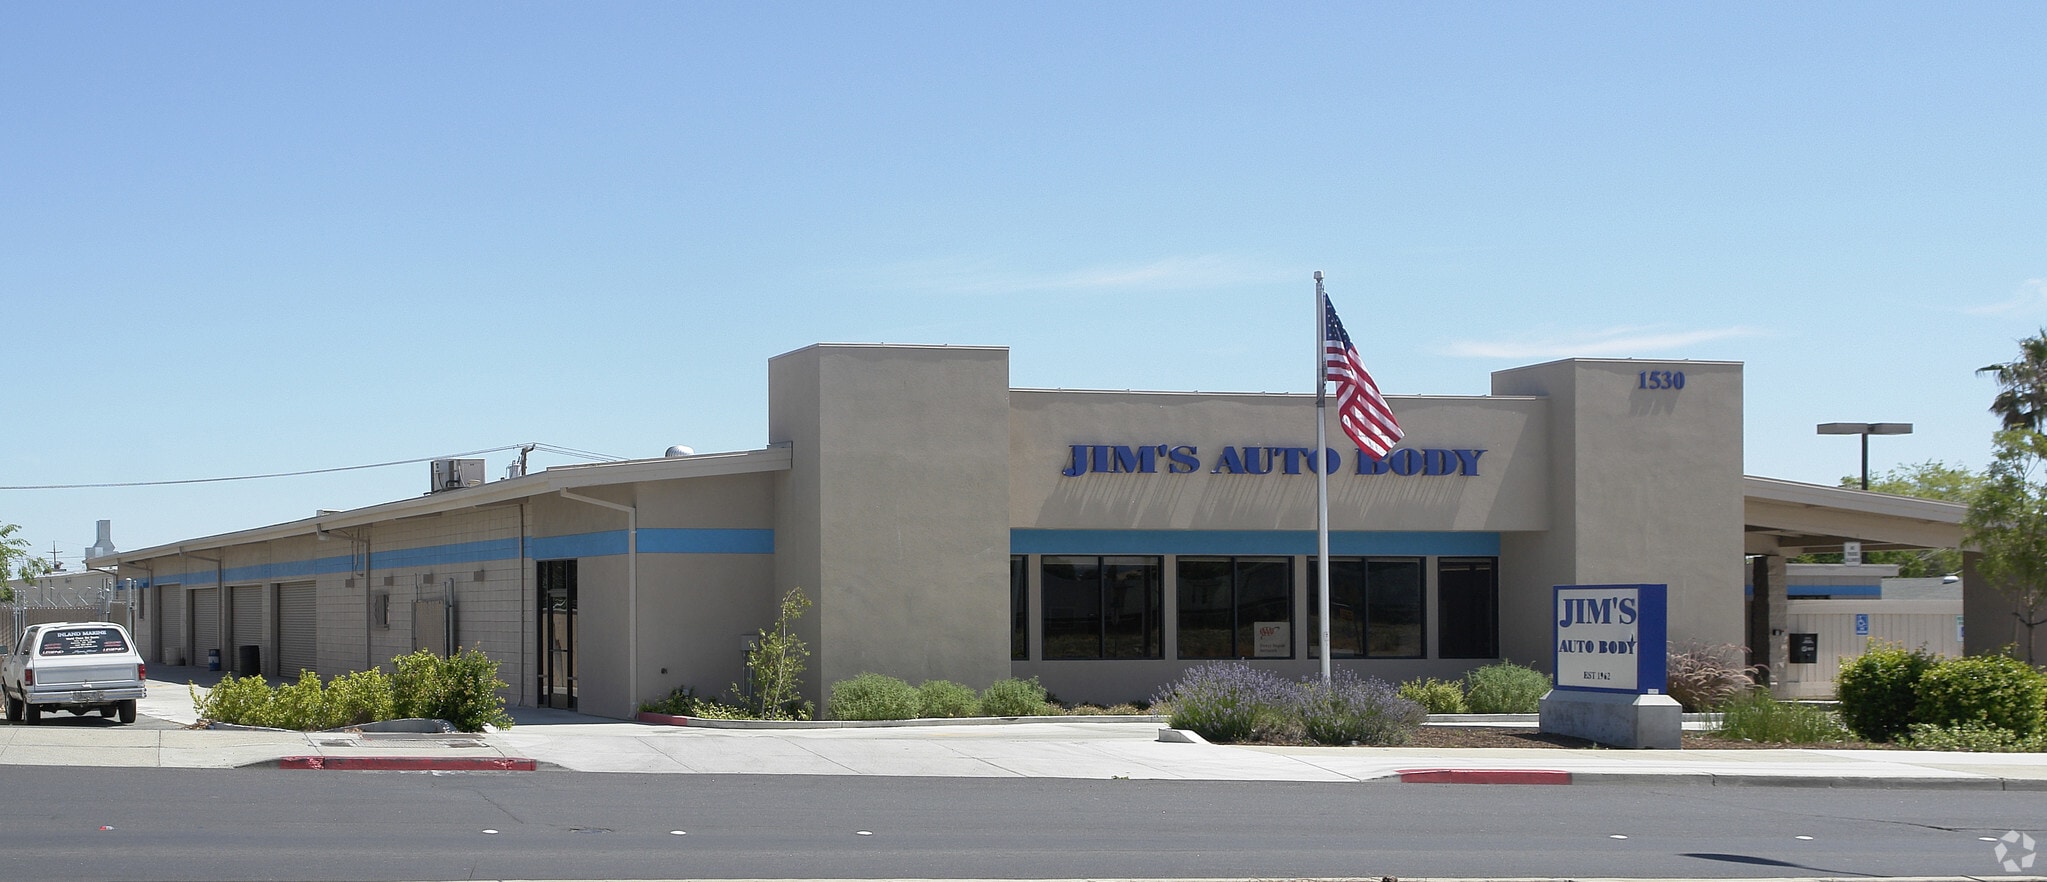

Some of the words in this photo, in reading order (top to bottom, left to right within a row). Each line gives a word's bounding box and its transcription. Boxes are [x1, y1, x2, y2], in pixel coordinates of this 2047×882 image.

[1638, 370, 1685, 390] 1530
[1062, 444, 1200, 477] JIM'S
[1210, 446, 1341, 476] AUTO
[1559, 596, 1637, 628] JIM'S
[1558, 639, 1595, 654] AUTO
[1598, 634, 1637, 655] BODY
[1583, 671, 1596, 680] EST
[1597, 672, 1611, 681] 1962
